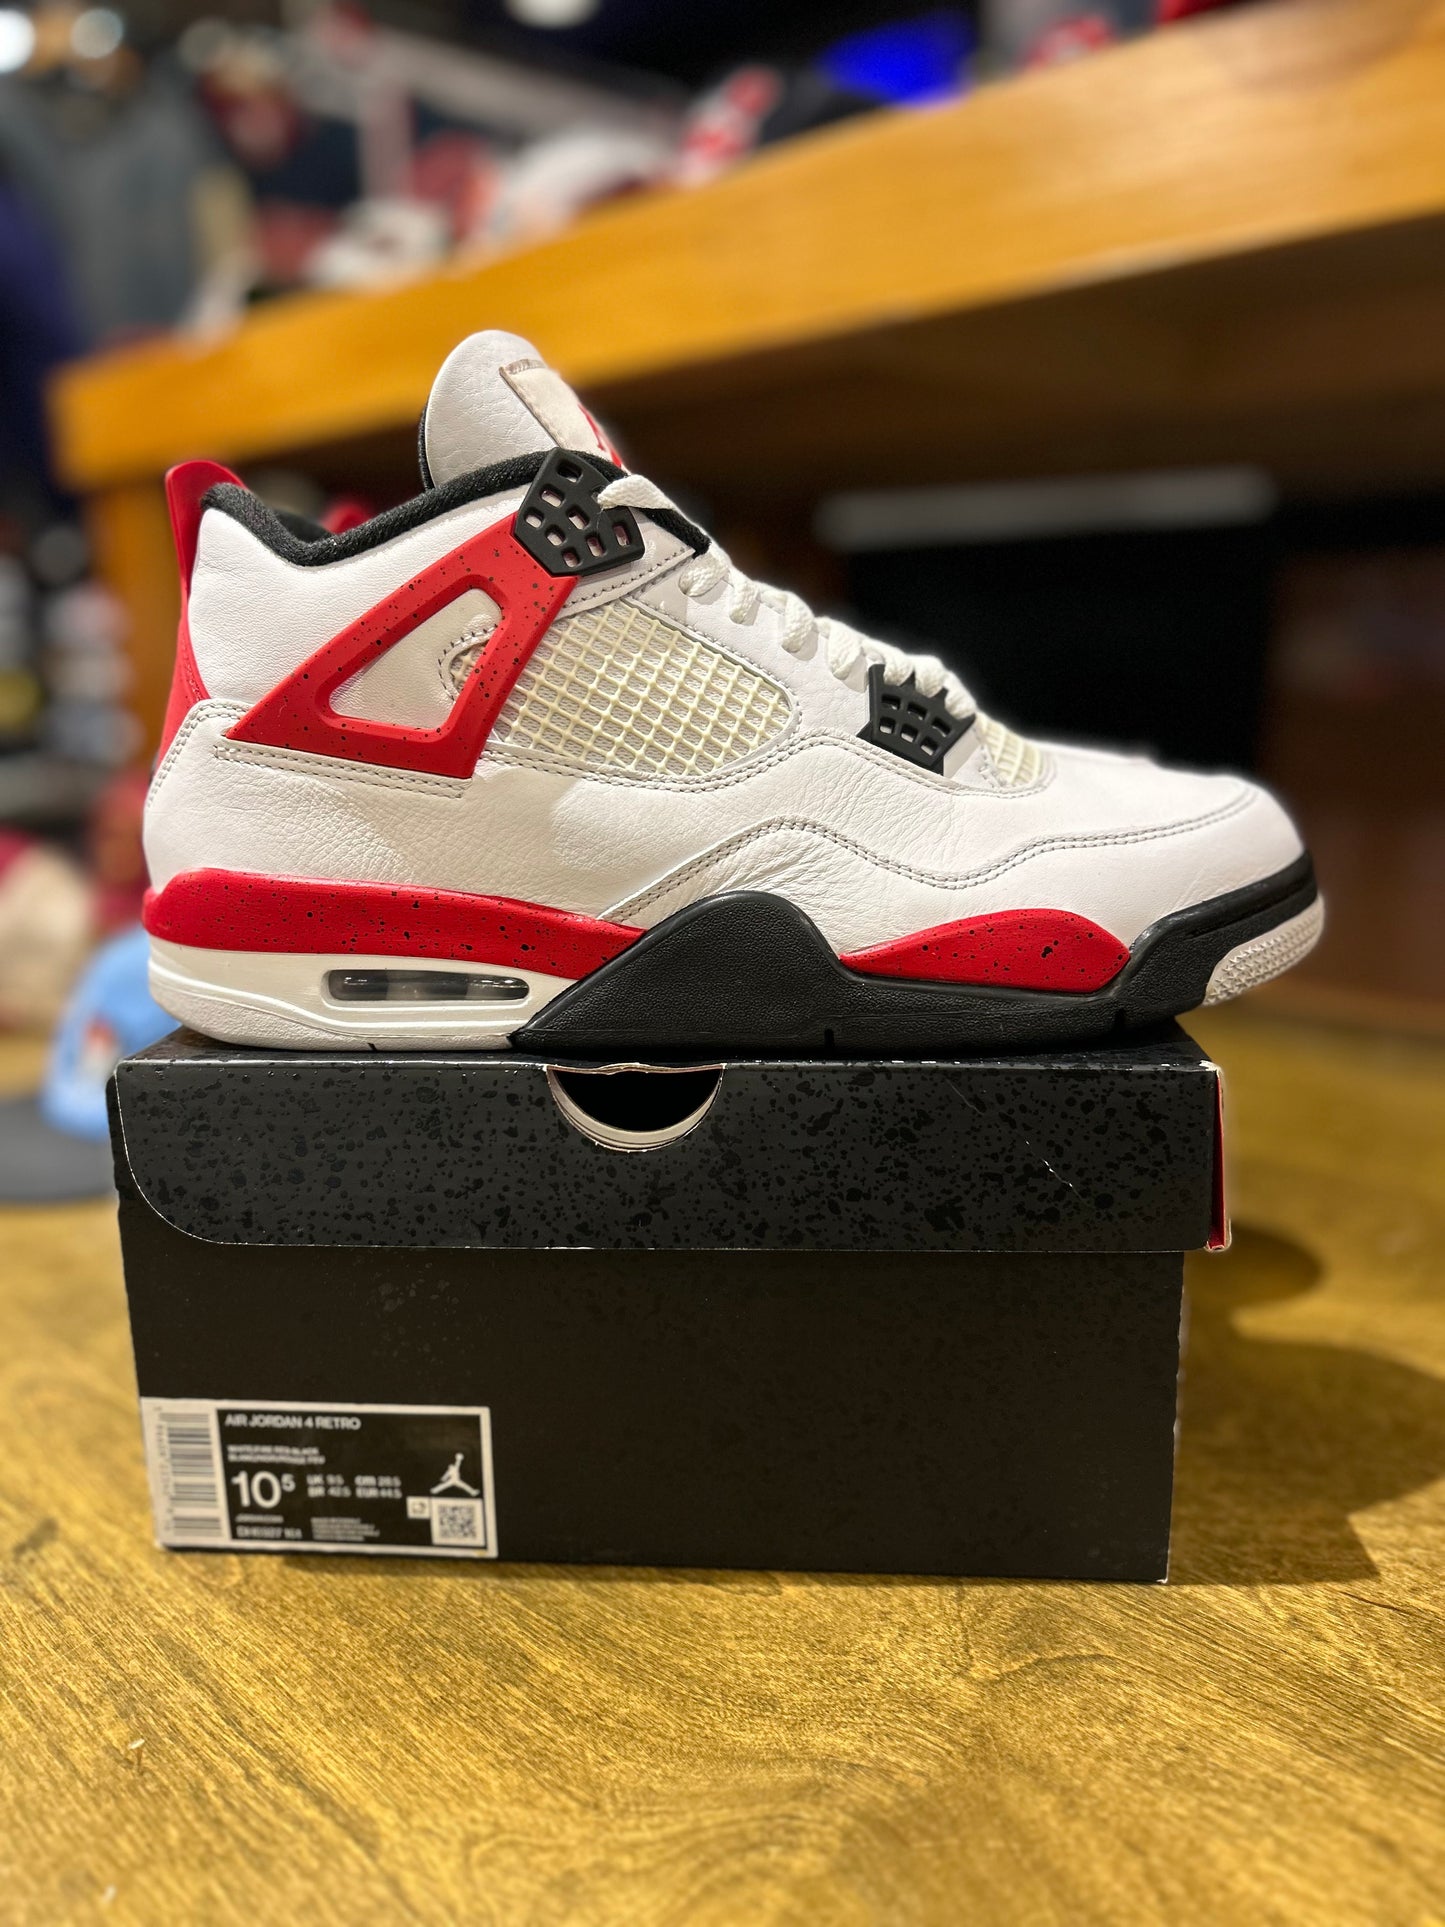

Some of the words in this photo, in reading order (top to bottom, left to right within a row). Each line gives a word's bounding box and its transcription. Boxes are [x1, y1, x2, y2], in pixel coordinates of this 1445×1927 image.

[224, 1413, 248, 1428] AIR
[249, 1414, 302, 1429] JORDAN
[304, 1416, 315, 1429] 4
[315, 1416, 362, 1430] RETRO
